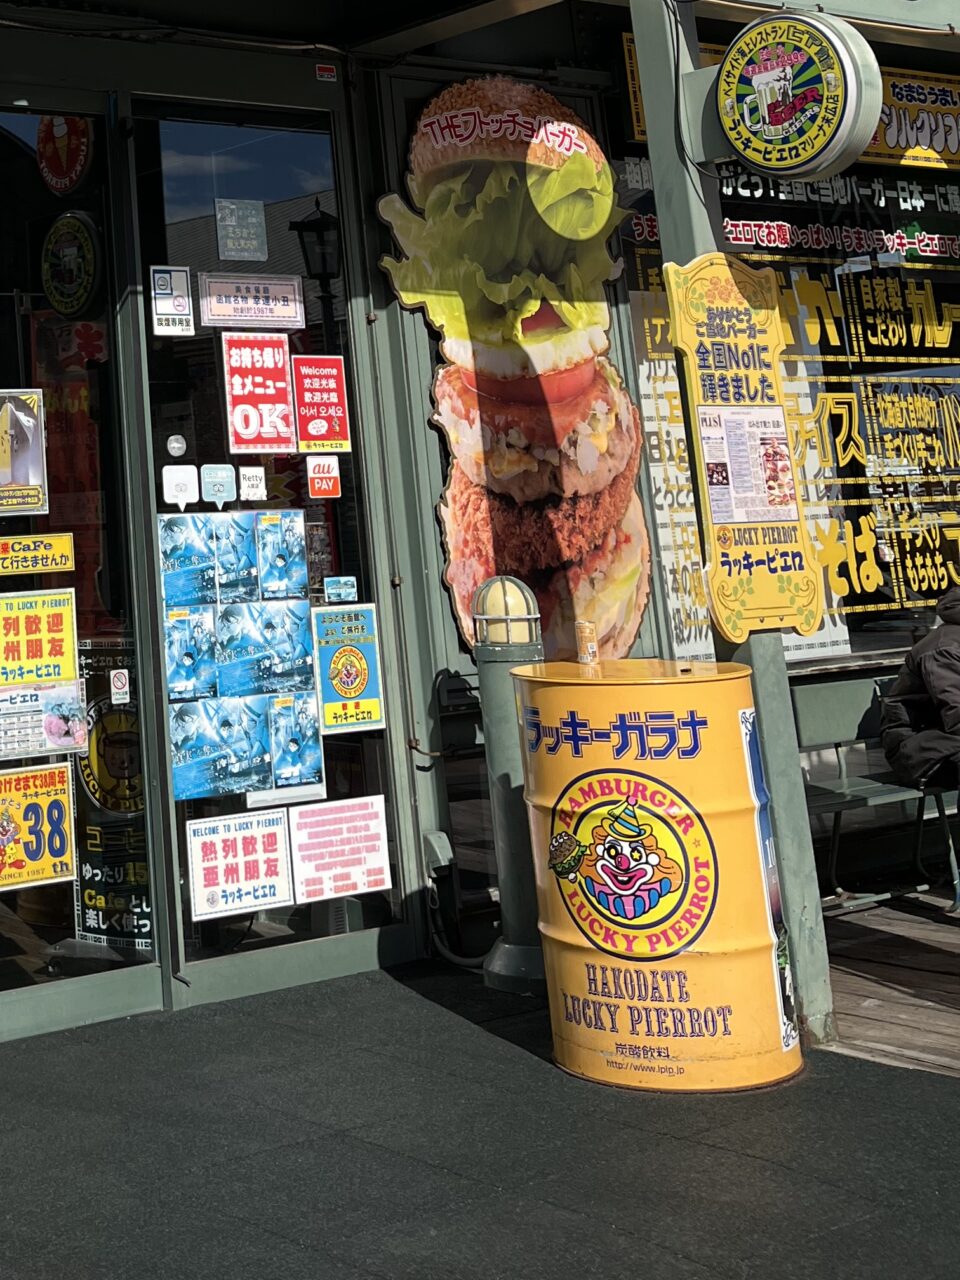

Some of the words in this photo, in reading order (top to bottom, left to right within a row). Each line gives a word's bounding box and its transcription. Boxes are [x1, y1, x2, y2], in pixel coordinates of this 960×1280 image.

[423, 108, 586, 154] THEフトッチョバーガー
[881, 104, 960, 155] シルクソフ
[216, 295, 249, 306] 函館名物
[252, 295, 290, 307] 幸運小丑
[861, 276, 903, 311] 自家製
[233, 306, 275, 316] 始創於1987年
[156, 317, 192, 328] 喫煙専用室
[696, 321, 768, 340] ご当地バーガー
[866, 312, 907, 347] こだわり
[229, 347, 284, 369] お持ち帰り
[695, 339, 772, 371] 全国No1に
[300, 365, 337, 376] Welcome
[231, 373, 287, 396] 全メニュー
[303, 377, 337, 389] 欢迎光临
[700, 371, 777, 404] 輝きました
[233, 403, 291, 440] OK
[300, 406, 318, 417] 어서
[319, 405, 344, 417] 오세요
[242, 473, 263, 485] Retty
[312, 464, 335, 475] au
[314, 478, 335, 491] PAY
[732, 526, 759, 547] LUCKY
[761, 525, 798, 545] PIERROT
[720, 548, 805, 578] ラッキーピエロ
[5, 602, 14, 611] TO
[17, 601, 38, 611] LUCKY
[42, 598, 70, 608] PIERROT
[1, 664, 61, 681] ラッキーピエロ
[332, 710, 373, 724] ラッキーピエロ
[522, 705, 708, 760] ラッキーガラナ
[22, 788, 67, 801] ラッキーピエロ
[557, 778, 696, 839] HAMBURGER
[22, 798, 68, 862] 38
[192, 825, 220, 838] WELCOME
[223, 823, 231, 834] TO
[234, 820, 254, 832] LUCKY
[257, 816, 283, 830] PIERROT
[0, 871, 24, 881] SINCE
[27, 867, 47, 878] 1987
[52, 861, 71, 875] th
[203, 857, 280, 889] 亜州朋友
[221, 884, 277, 905] ラッキーピエロ
[566, 888, 640, 954] LUCKY
[646, 856, 712, 954] PIERROT
[584, 962, 690, 1004] HAKODATE
[561, 992, 620, 1036] LUCKY
[628, 1004, 734, 1039] PIERROT
[614, 1042, 671, 1060] 炭酸飲料
